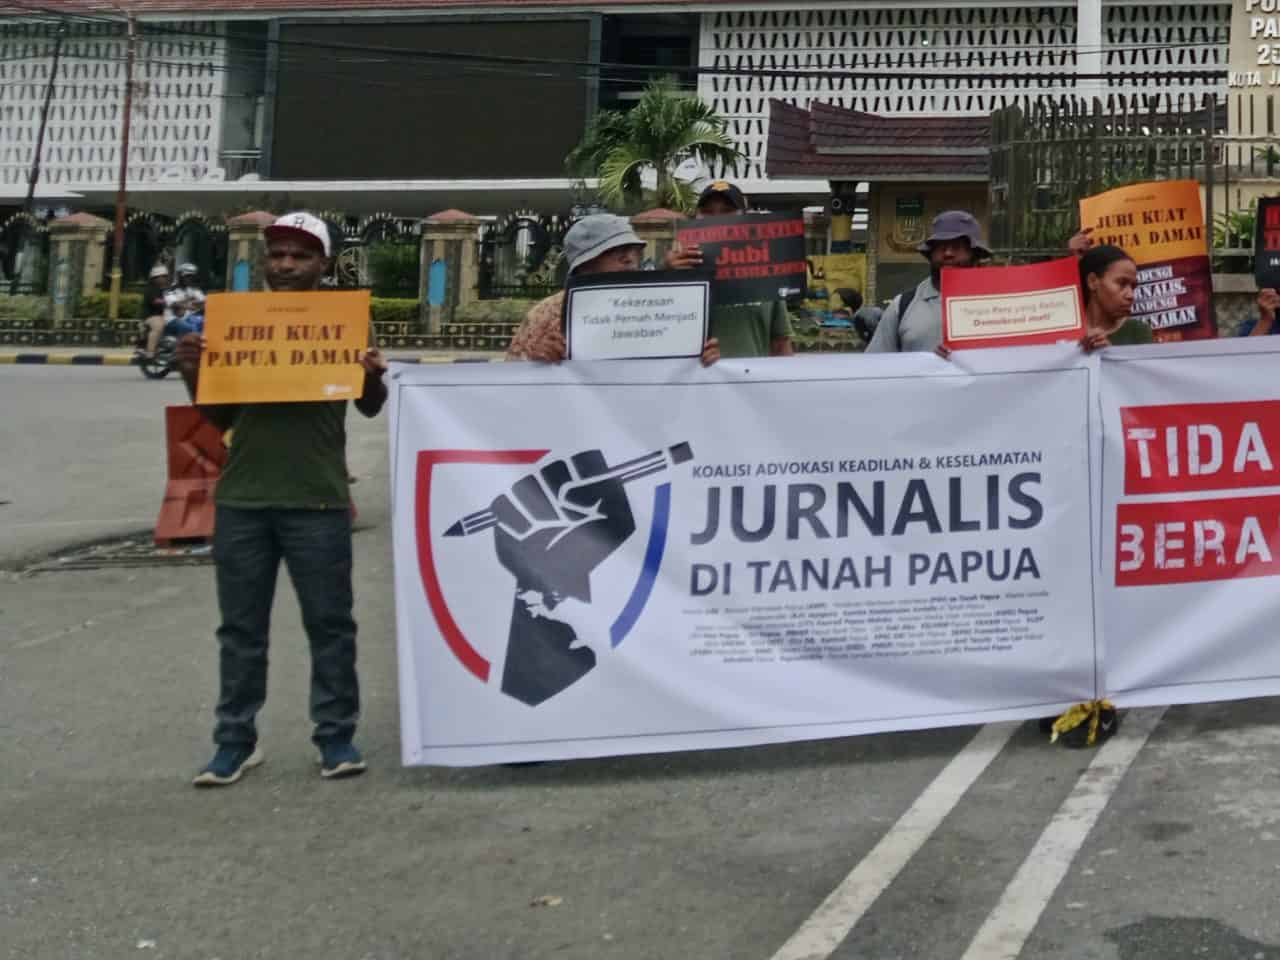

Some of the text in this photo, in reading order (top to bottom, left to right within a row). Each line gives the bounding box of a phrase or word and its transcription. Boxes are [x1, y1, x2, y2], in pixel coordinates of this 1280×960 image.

[1229, 71, 1261, 87] KOTA
[1095, 208, 1188, 229] JUBI KUAT
[1090, 226, 1202, 248] APUA DAMAI
[716, 241, 769, 264] Jubi
[223, 324, 347, 341] JUBI KUAT
[206, 349, 363, 367] PAPUA DAMAI
[692, 450, 1043, 479] KOALISI ADVOKASI KEADILAN & KESELAMATAN
[689, 472, 1044, 545] JURNALIS
[690, 547, 1041, 596] DI TANAH PAPUA
